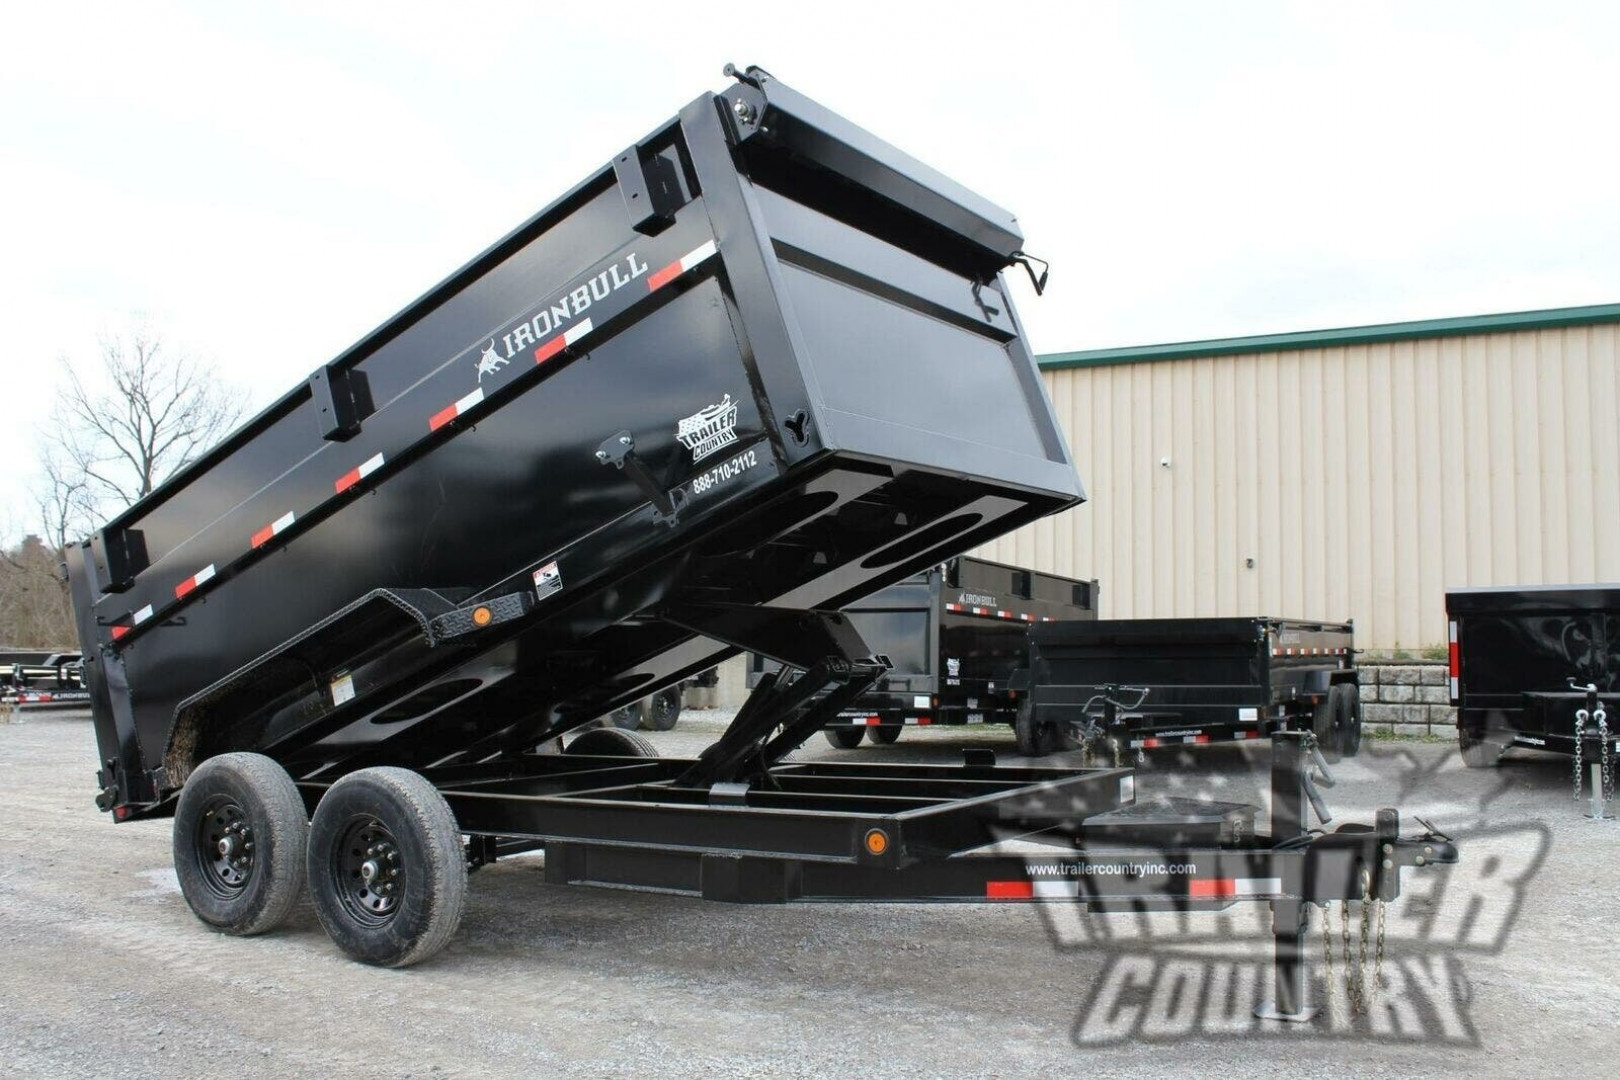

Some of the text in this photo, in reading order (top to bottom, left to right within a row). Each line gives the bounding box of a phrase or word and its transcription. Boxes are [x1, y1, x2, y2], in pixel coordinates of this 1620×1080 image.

[502, 252, 649, 359] IRONBULL
[679, 407, 737, 449] TRAILER
[693, 428, 737, 460] COUNTRY
[692, 450, 758, 494] 888-710-2112
[1025, 861, 1197, 878] www.trailercountryinc.com
